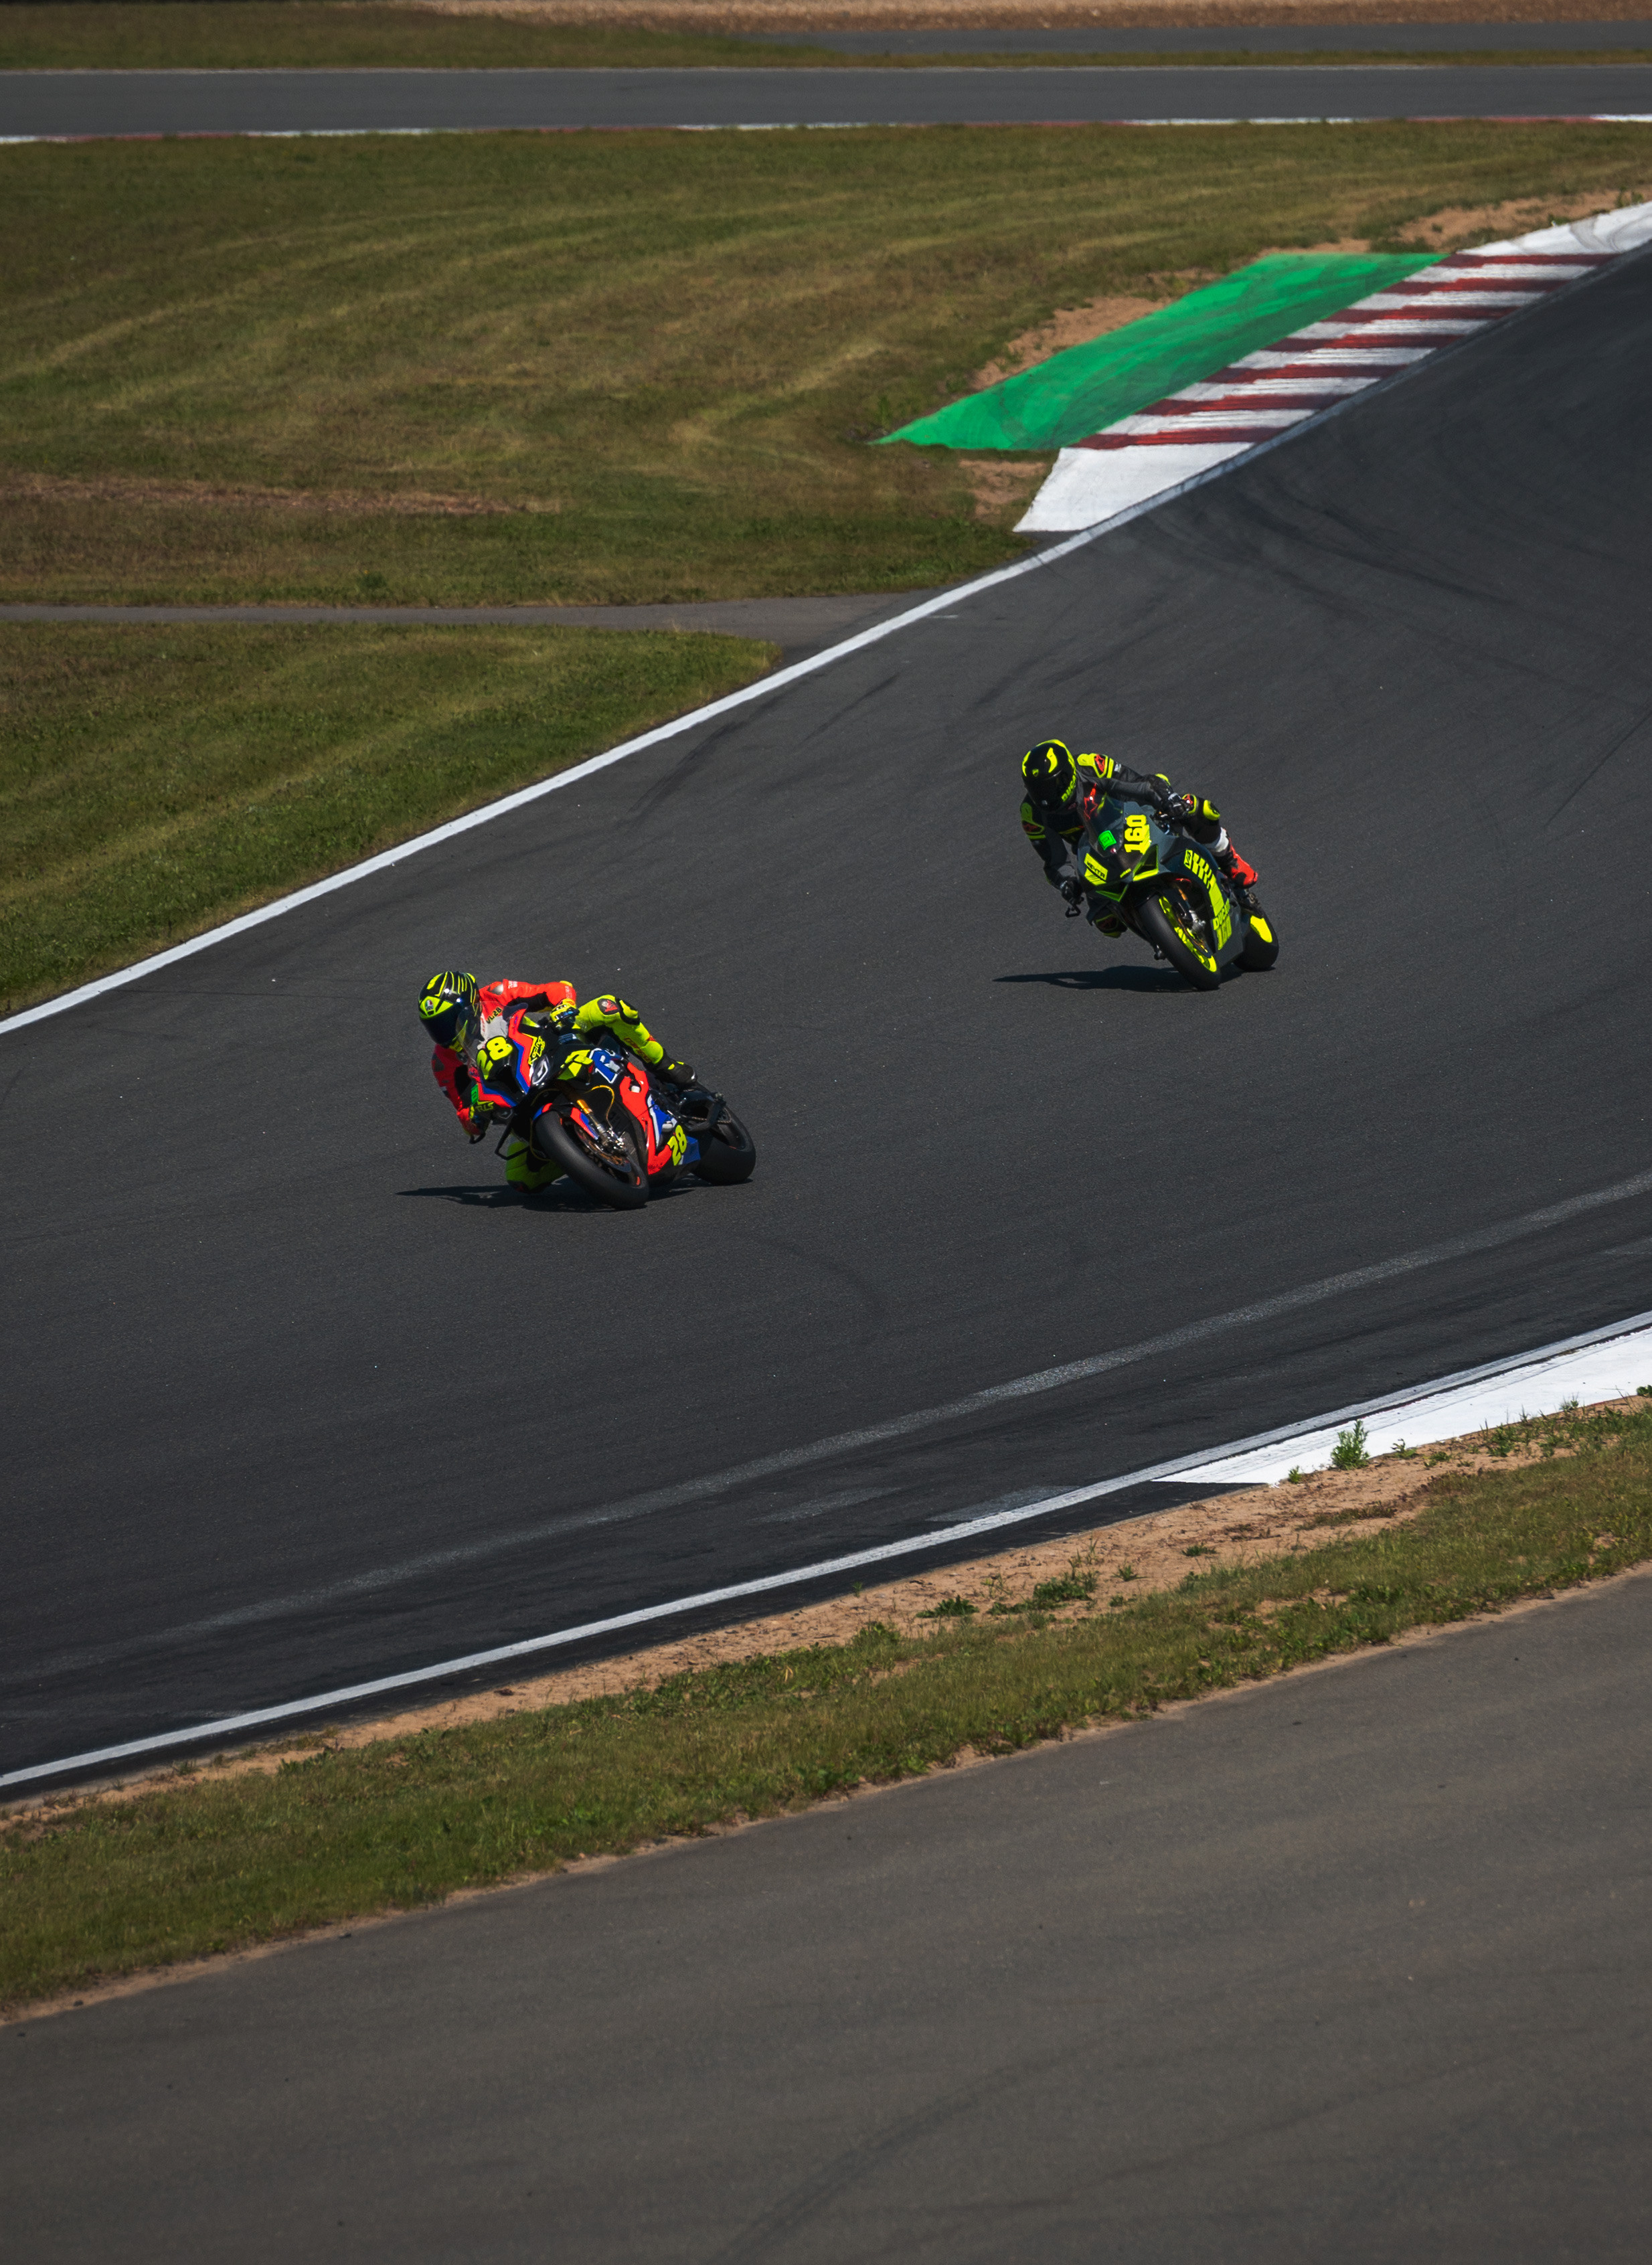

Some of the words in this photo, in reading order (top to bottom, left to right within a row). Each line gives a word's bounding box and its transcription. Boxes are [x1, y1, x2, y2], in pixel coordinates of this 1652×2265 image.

[1124, 814, 1147, 854] 160
[477, 1036, 513, 1080] 28
[667, 1125, 687, 1166] 28
